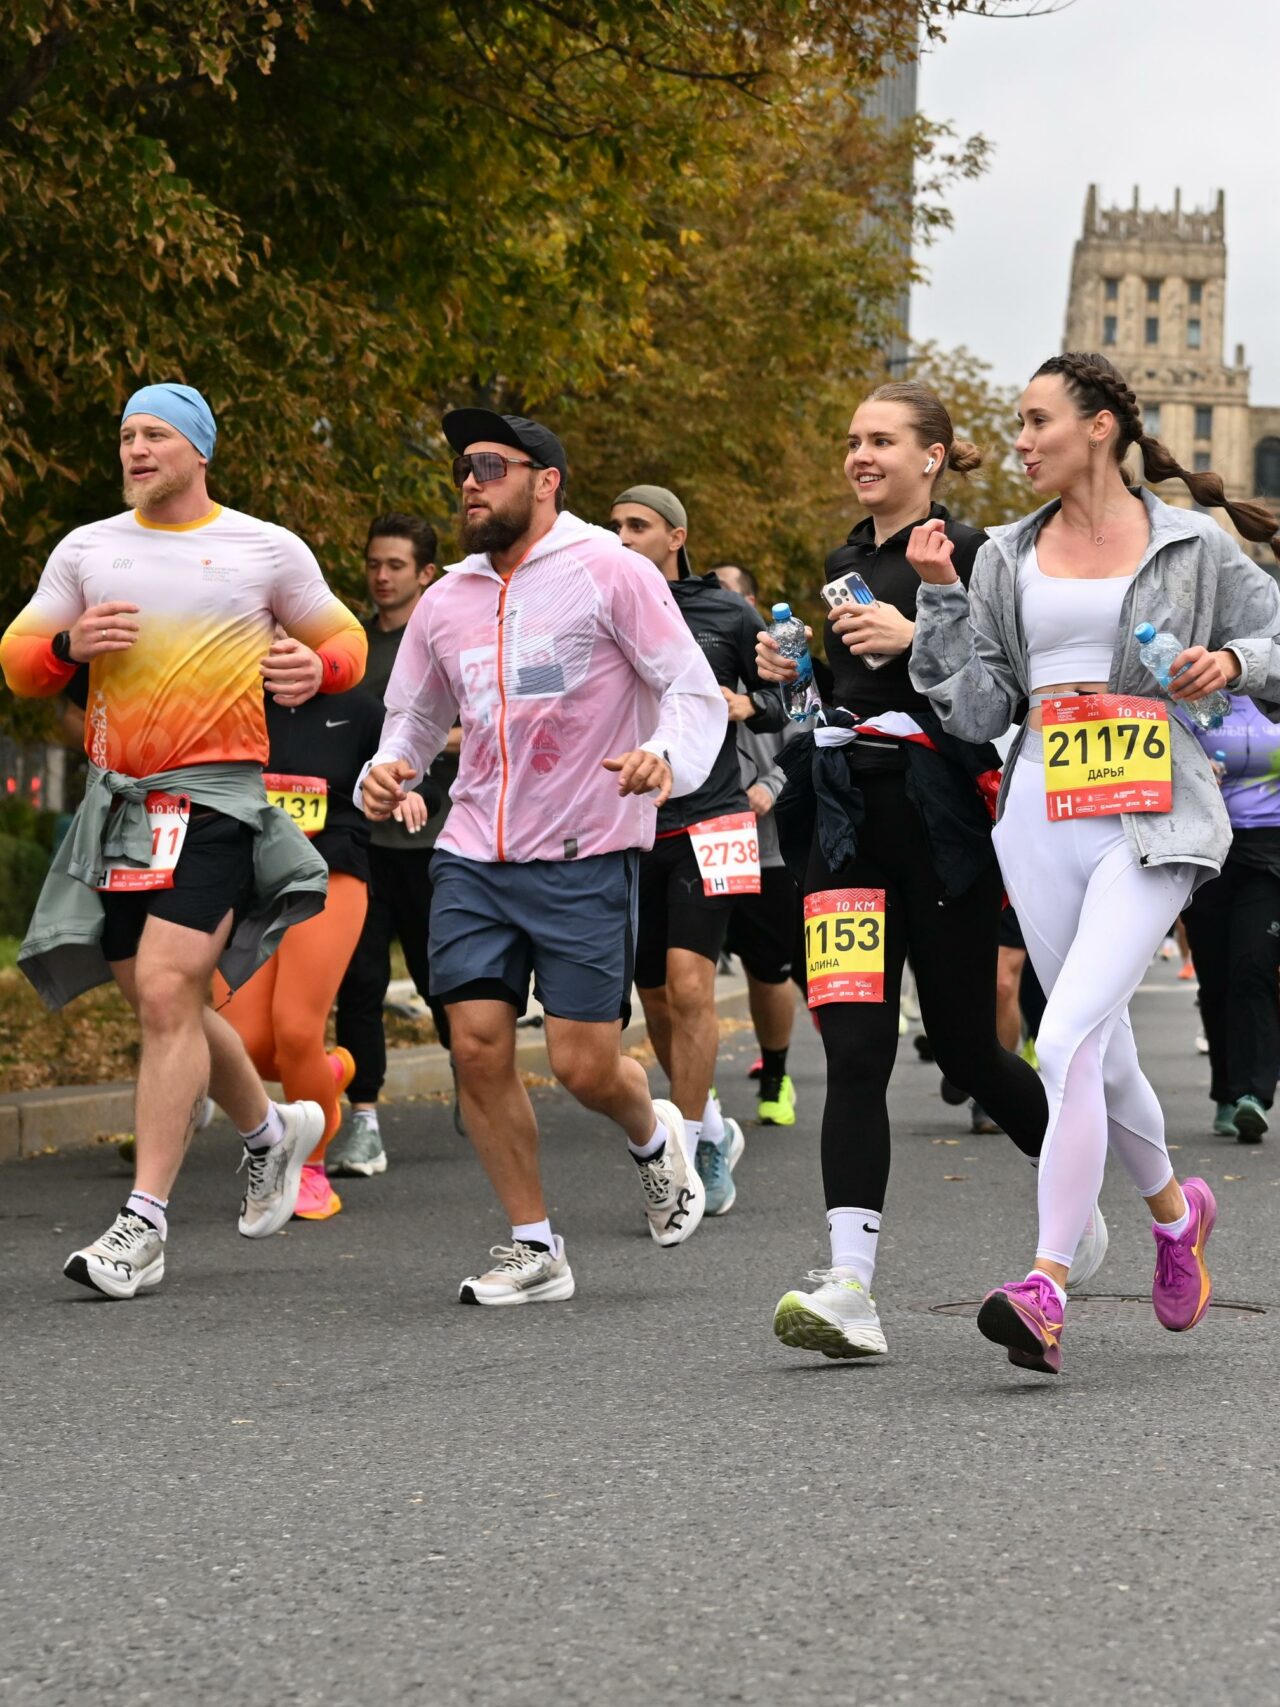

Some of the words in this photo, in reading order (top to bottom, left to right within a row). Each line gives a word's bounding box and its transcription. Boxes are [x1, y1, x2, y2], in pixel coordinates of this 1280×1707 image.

[1117, 707, 1132, 717] 10
[98, 704, 107, 769] ОСКВА
[1048, 724, 1165, 768] 21176
[1088, 766, 1124, 781] ДАРЬЯ
[1056, 794, 1073, 817] H
[835, 901, 850, 911] 10
[663, 1188, 696, 1230] TYR
